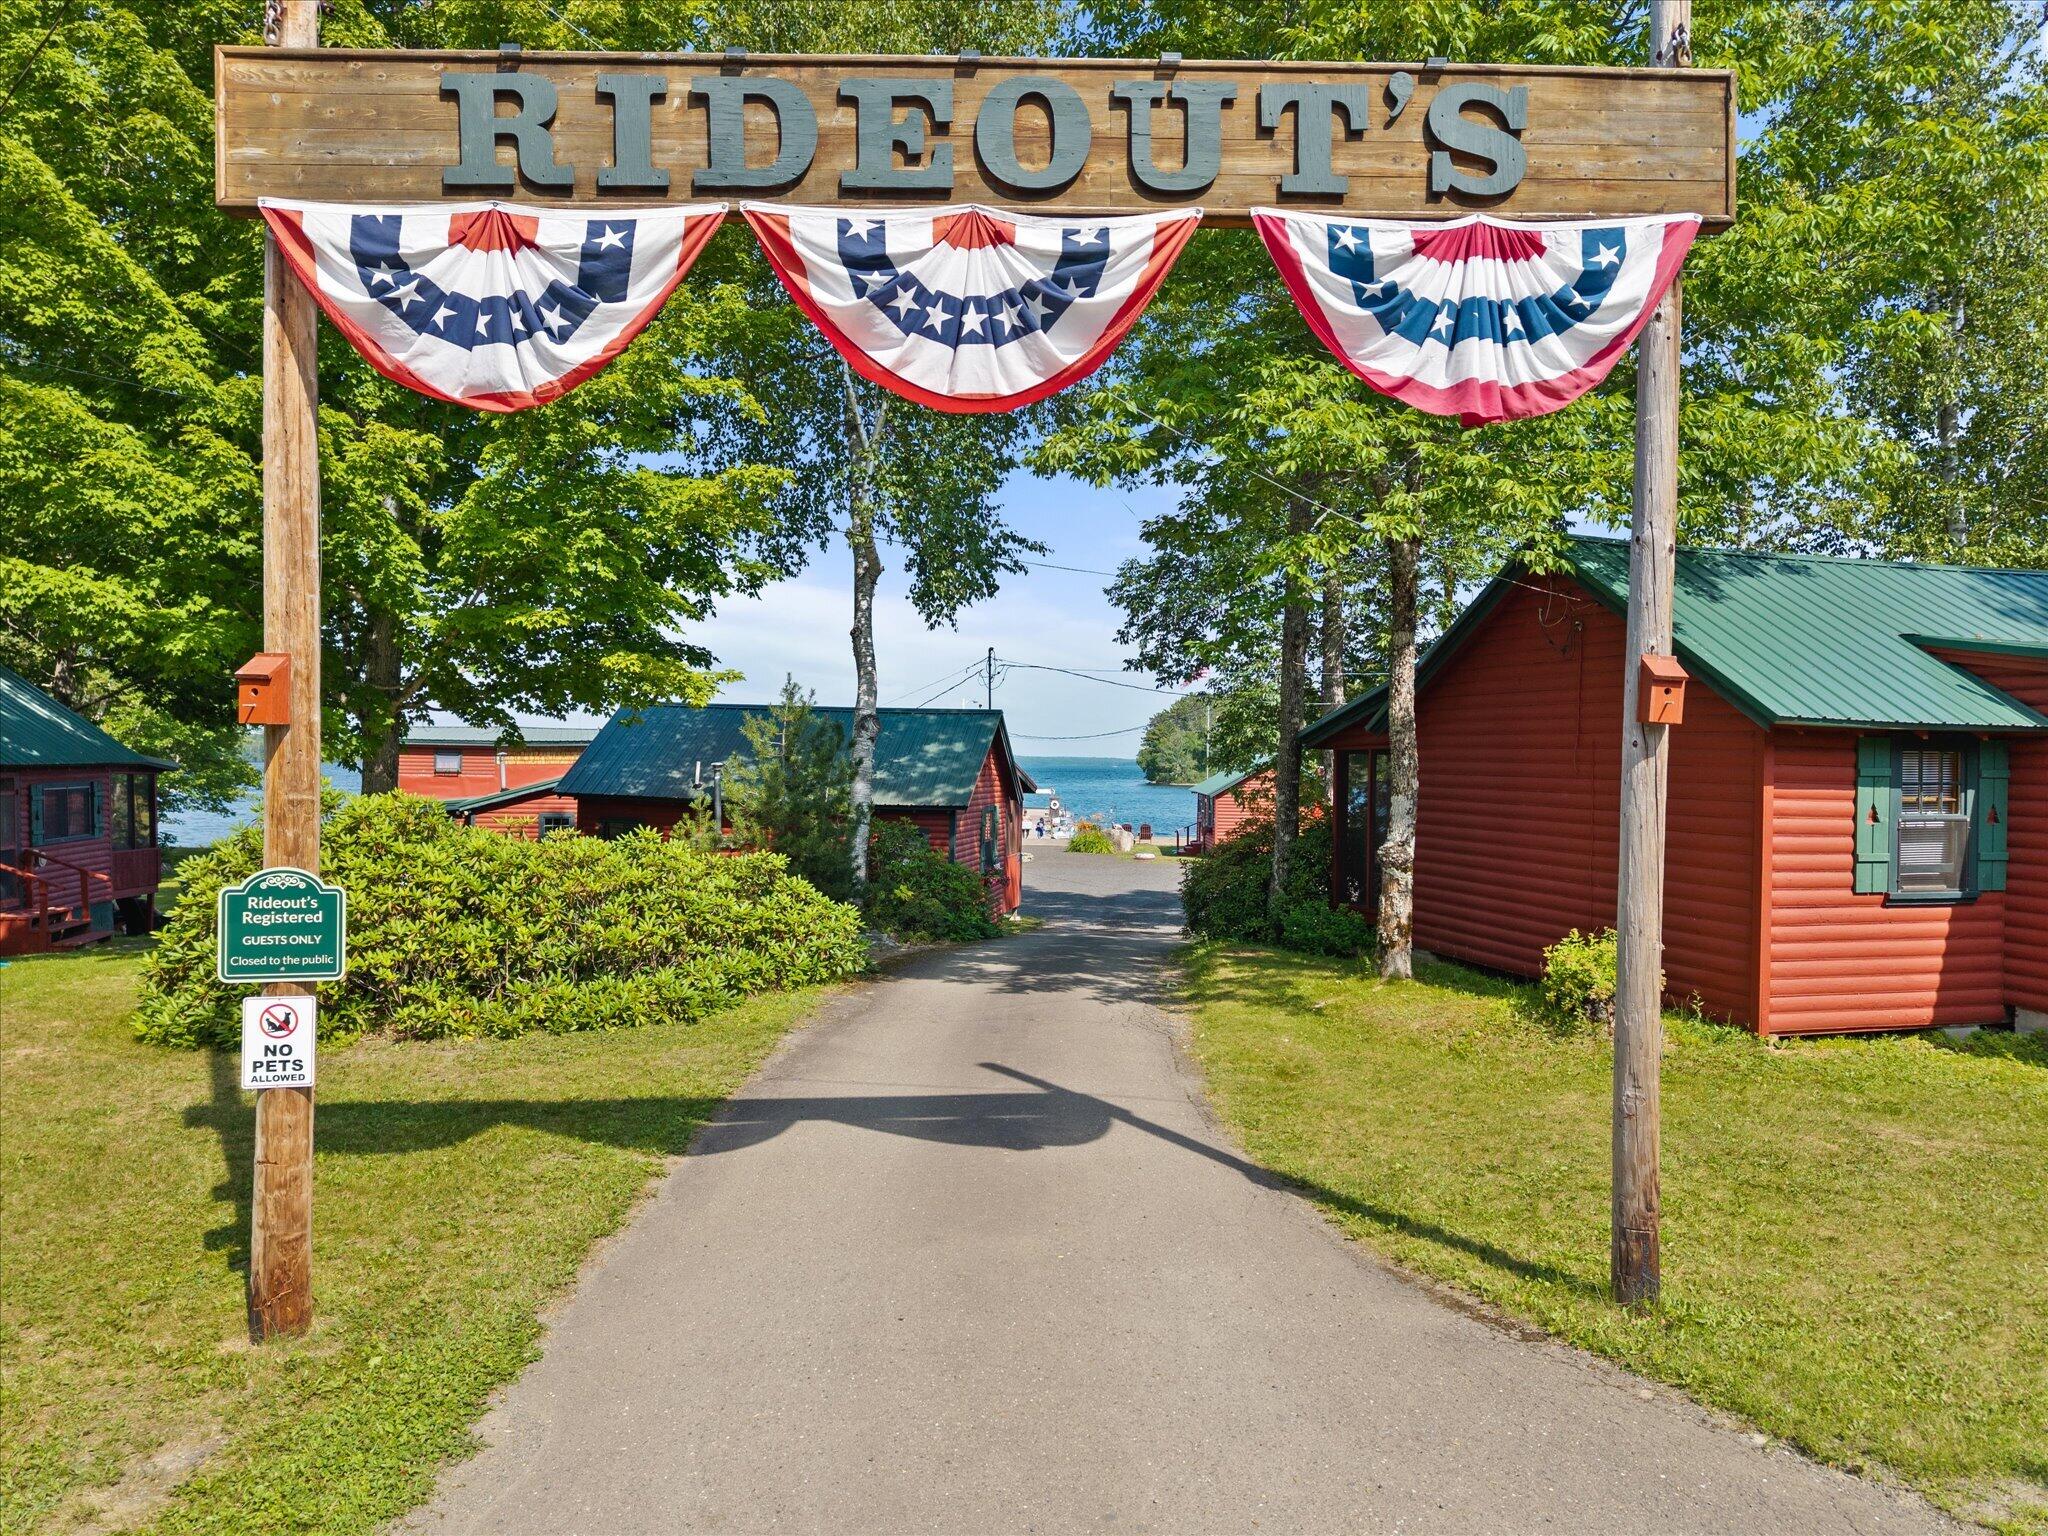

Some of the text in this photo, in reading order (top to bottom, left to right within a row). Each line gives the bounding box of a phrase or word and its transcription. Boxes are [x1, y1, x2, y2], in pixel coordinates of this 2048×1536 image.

[440, 71, 1528, 197] RIDEOUT'S
[247, 896, 318, 910] Rideout's
[242, 911, 323, 926] Registered
[242, 934, 322, 946] GUESTS ONLY
[230, 954, 334, 968] Closed to the public
[264, 1044, 293, 1057] NO
[252, 1059, 304, 1073] PETS
[250, 1073, 306, 1083] ALLOWED
